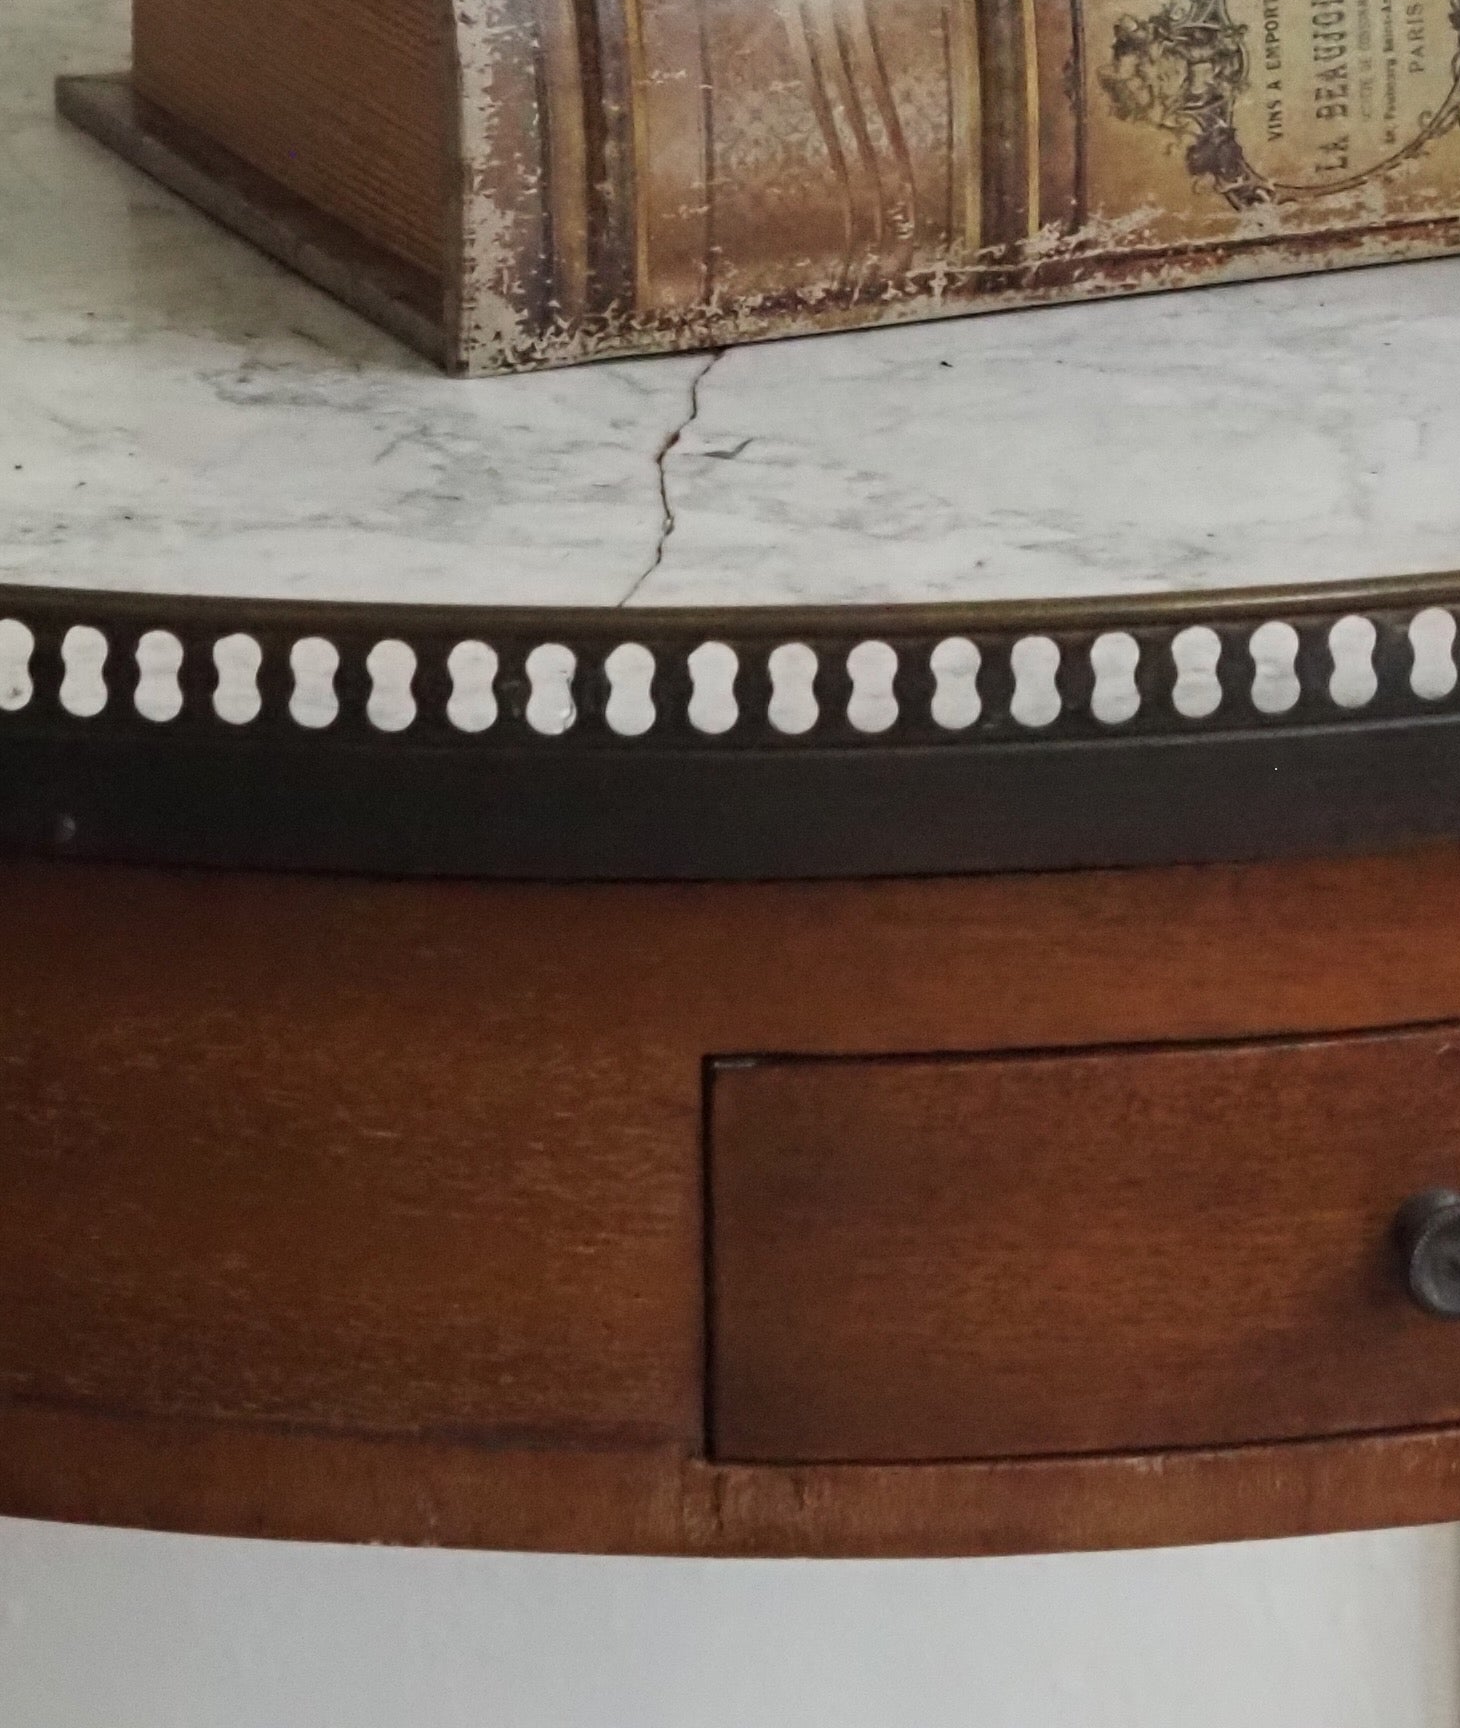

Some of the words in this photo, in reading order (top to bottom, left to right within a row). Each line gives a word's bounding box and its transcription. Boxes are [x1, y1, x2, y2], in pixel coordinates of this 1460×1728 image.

[1406, 2, 1425, 73] PARIS
[1267, 100, 1283, 141] VINS
[1315, 135, 1349, 172] LA
